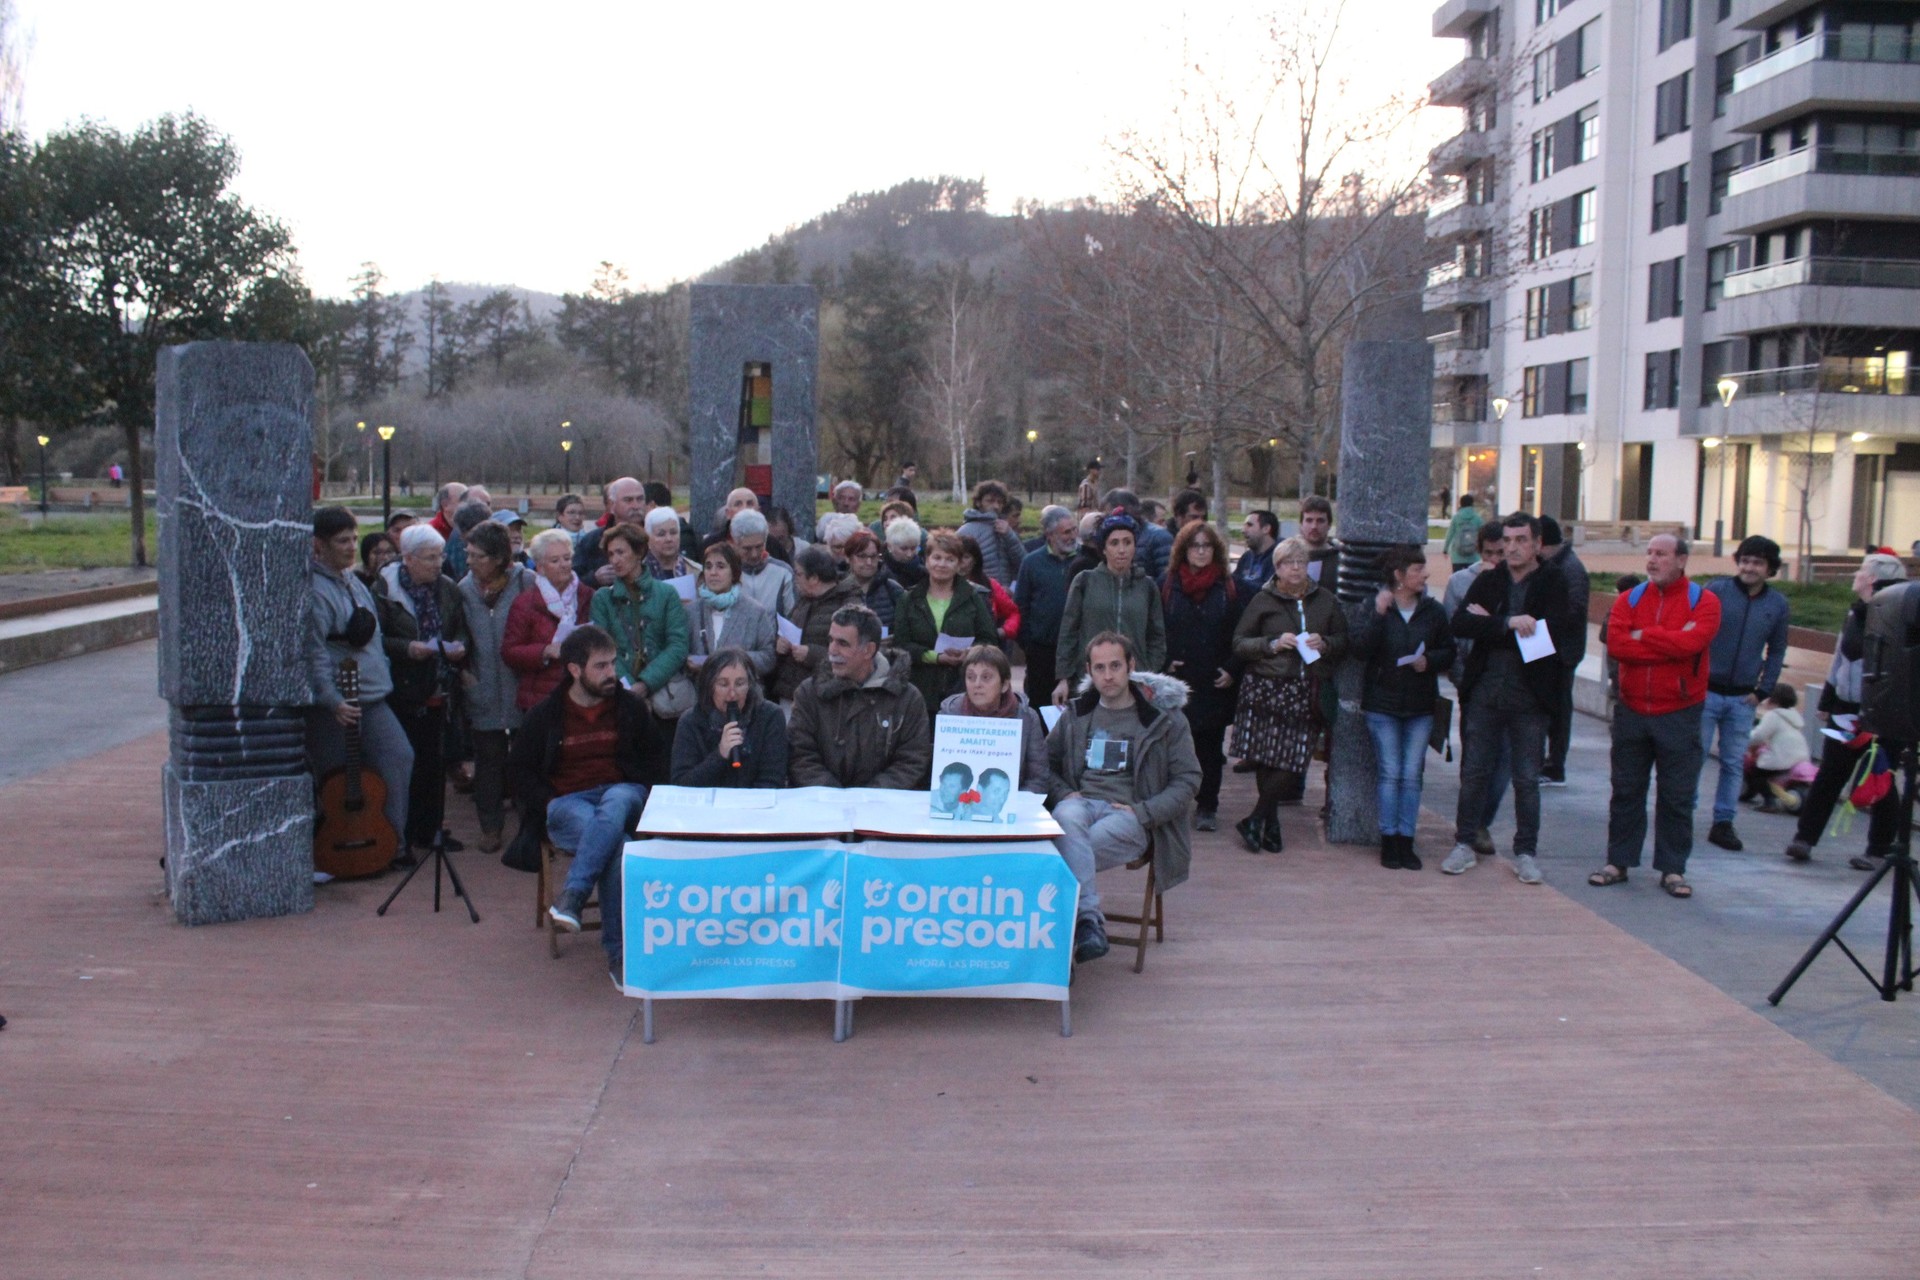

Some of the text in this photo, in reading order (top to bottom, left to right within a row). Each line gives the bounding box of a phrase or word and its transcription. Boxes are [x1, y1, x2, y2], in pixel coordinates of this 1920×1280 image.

[940, 726, 1017, 736] URRUNKETAREKIN
[960, 738, 996, 746] AMAITU!
[678, 873, 808, 914] orain
[898, 875, 1024, 916] orain
[643, 909, 841, 954] presoak
[861, 912, 1057, 954] presoak
[690, 957, 796, 968] AHORA LXS PRESXS
[906, 958, 946, 968] AHORA
[969, 959, 1010, 970] PRESXS
